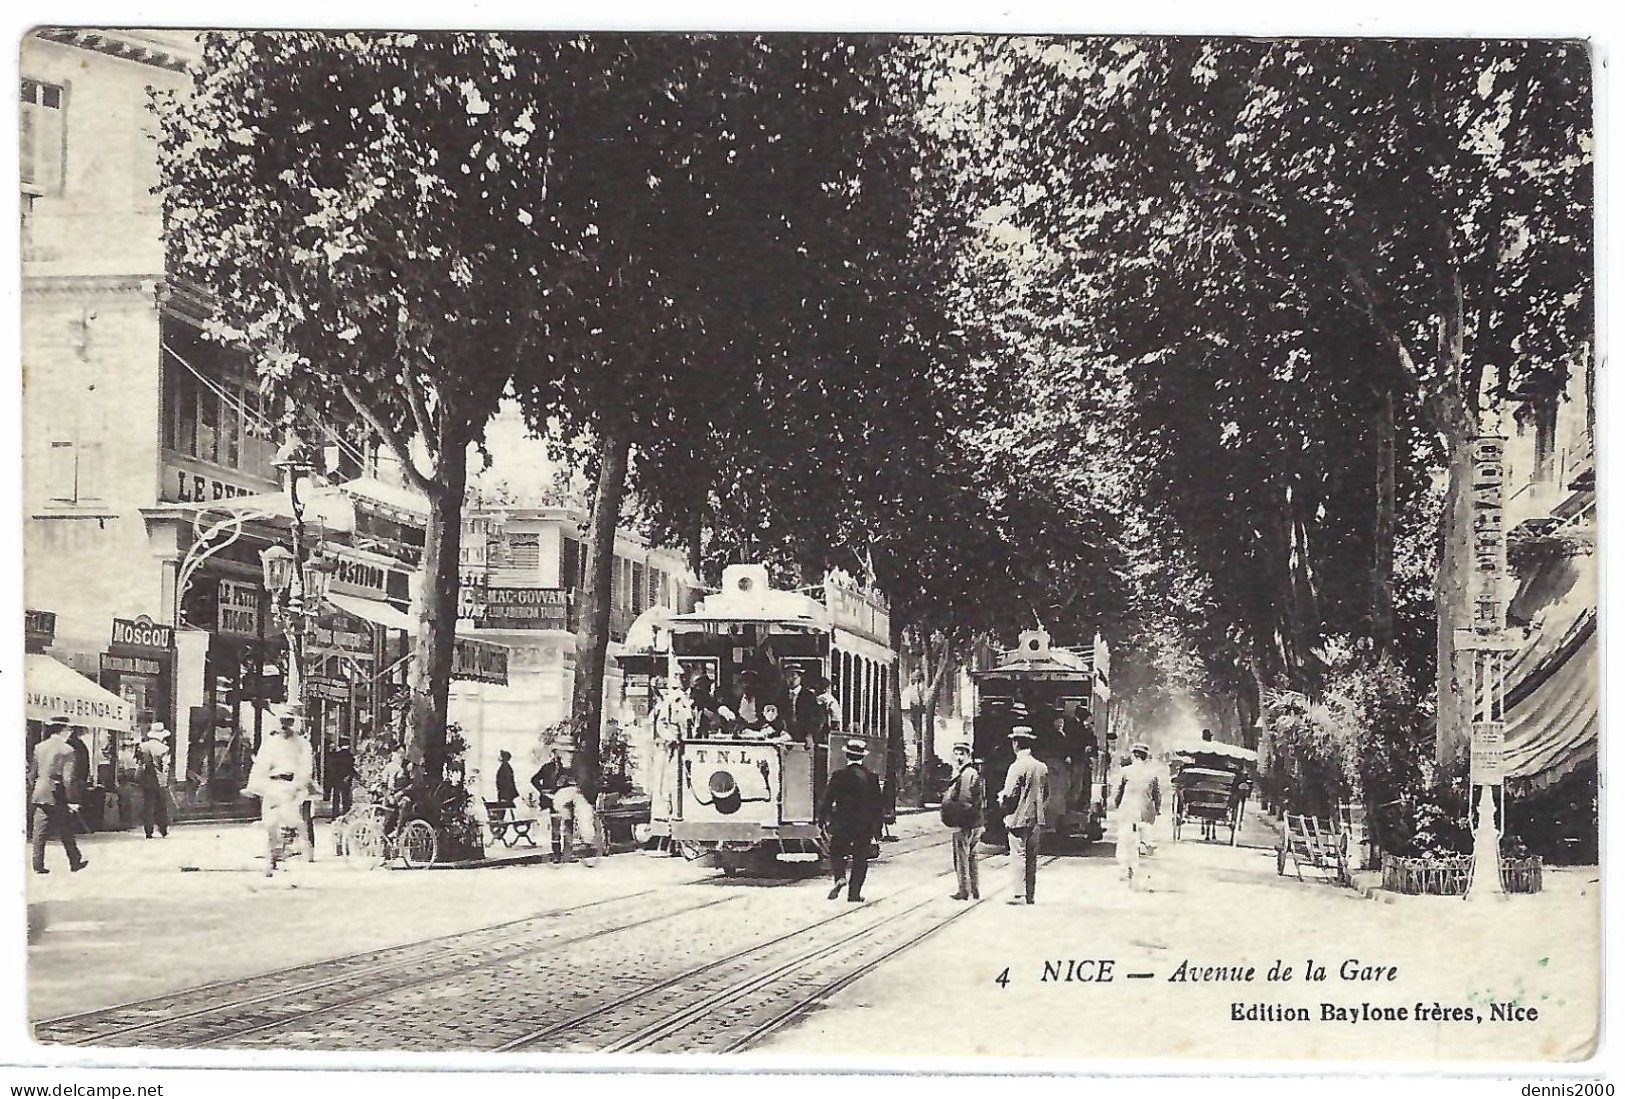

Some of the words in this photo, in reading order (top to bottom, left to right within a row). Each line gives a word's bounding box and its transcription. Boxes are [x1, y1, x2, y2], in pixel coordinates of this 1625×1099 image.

[178, 471, 206, 502] LE
[488, 590, 567, 604] MAC-GOWAN
[114, 622, 170, 647] MOSCOU
[77, 699, 123, 720] BENGALE
